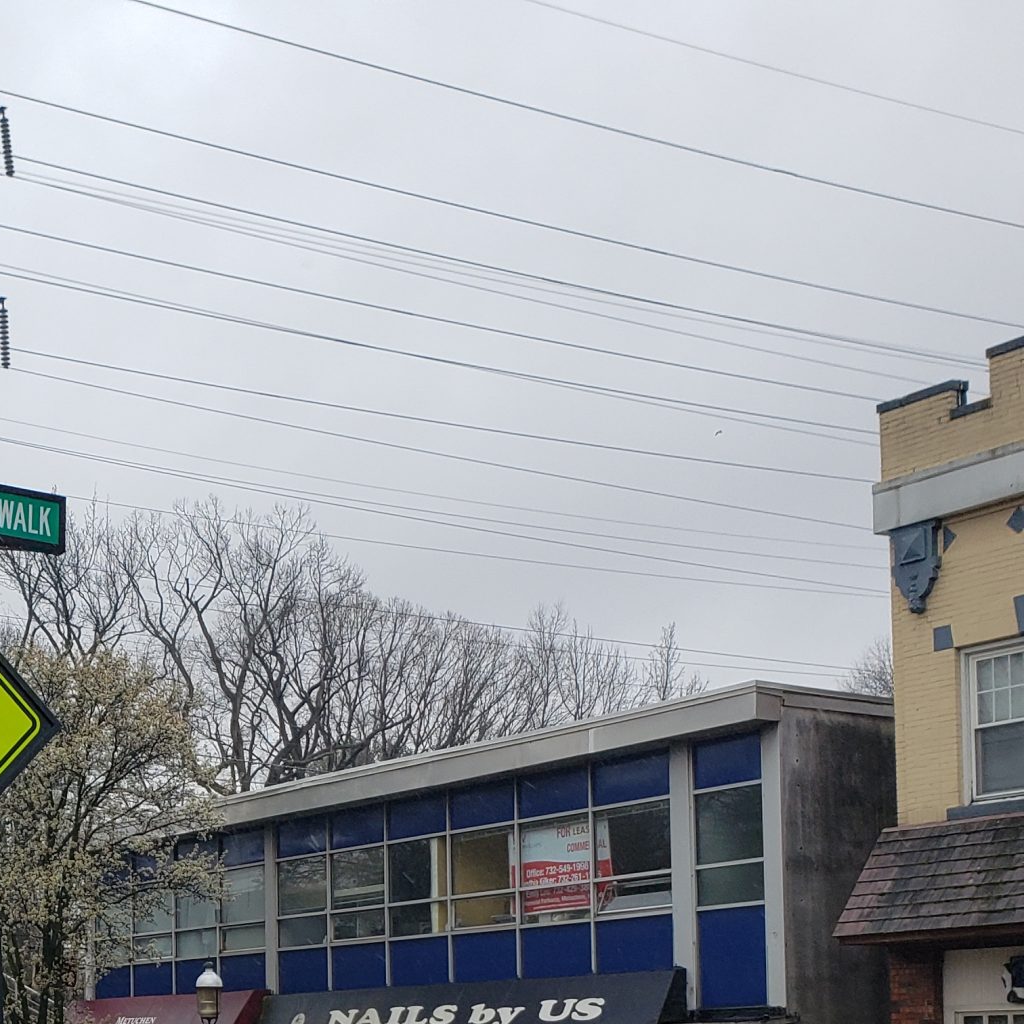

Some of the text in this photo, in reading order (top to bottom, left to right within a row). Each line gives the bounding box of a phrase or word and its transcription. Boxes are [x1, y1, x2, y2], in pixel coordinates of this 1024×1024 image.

[557, 825, 590, 838] FOR LEAS
[538, 997, 605, 1022] US
